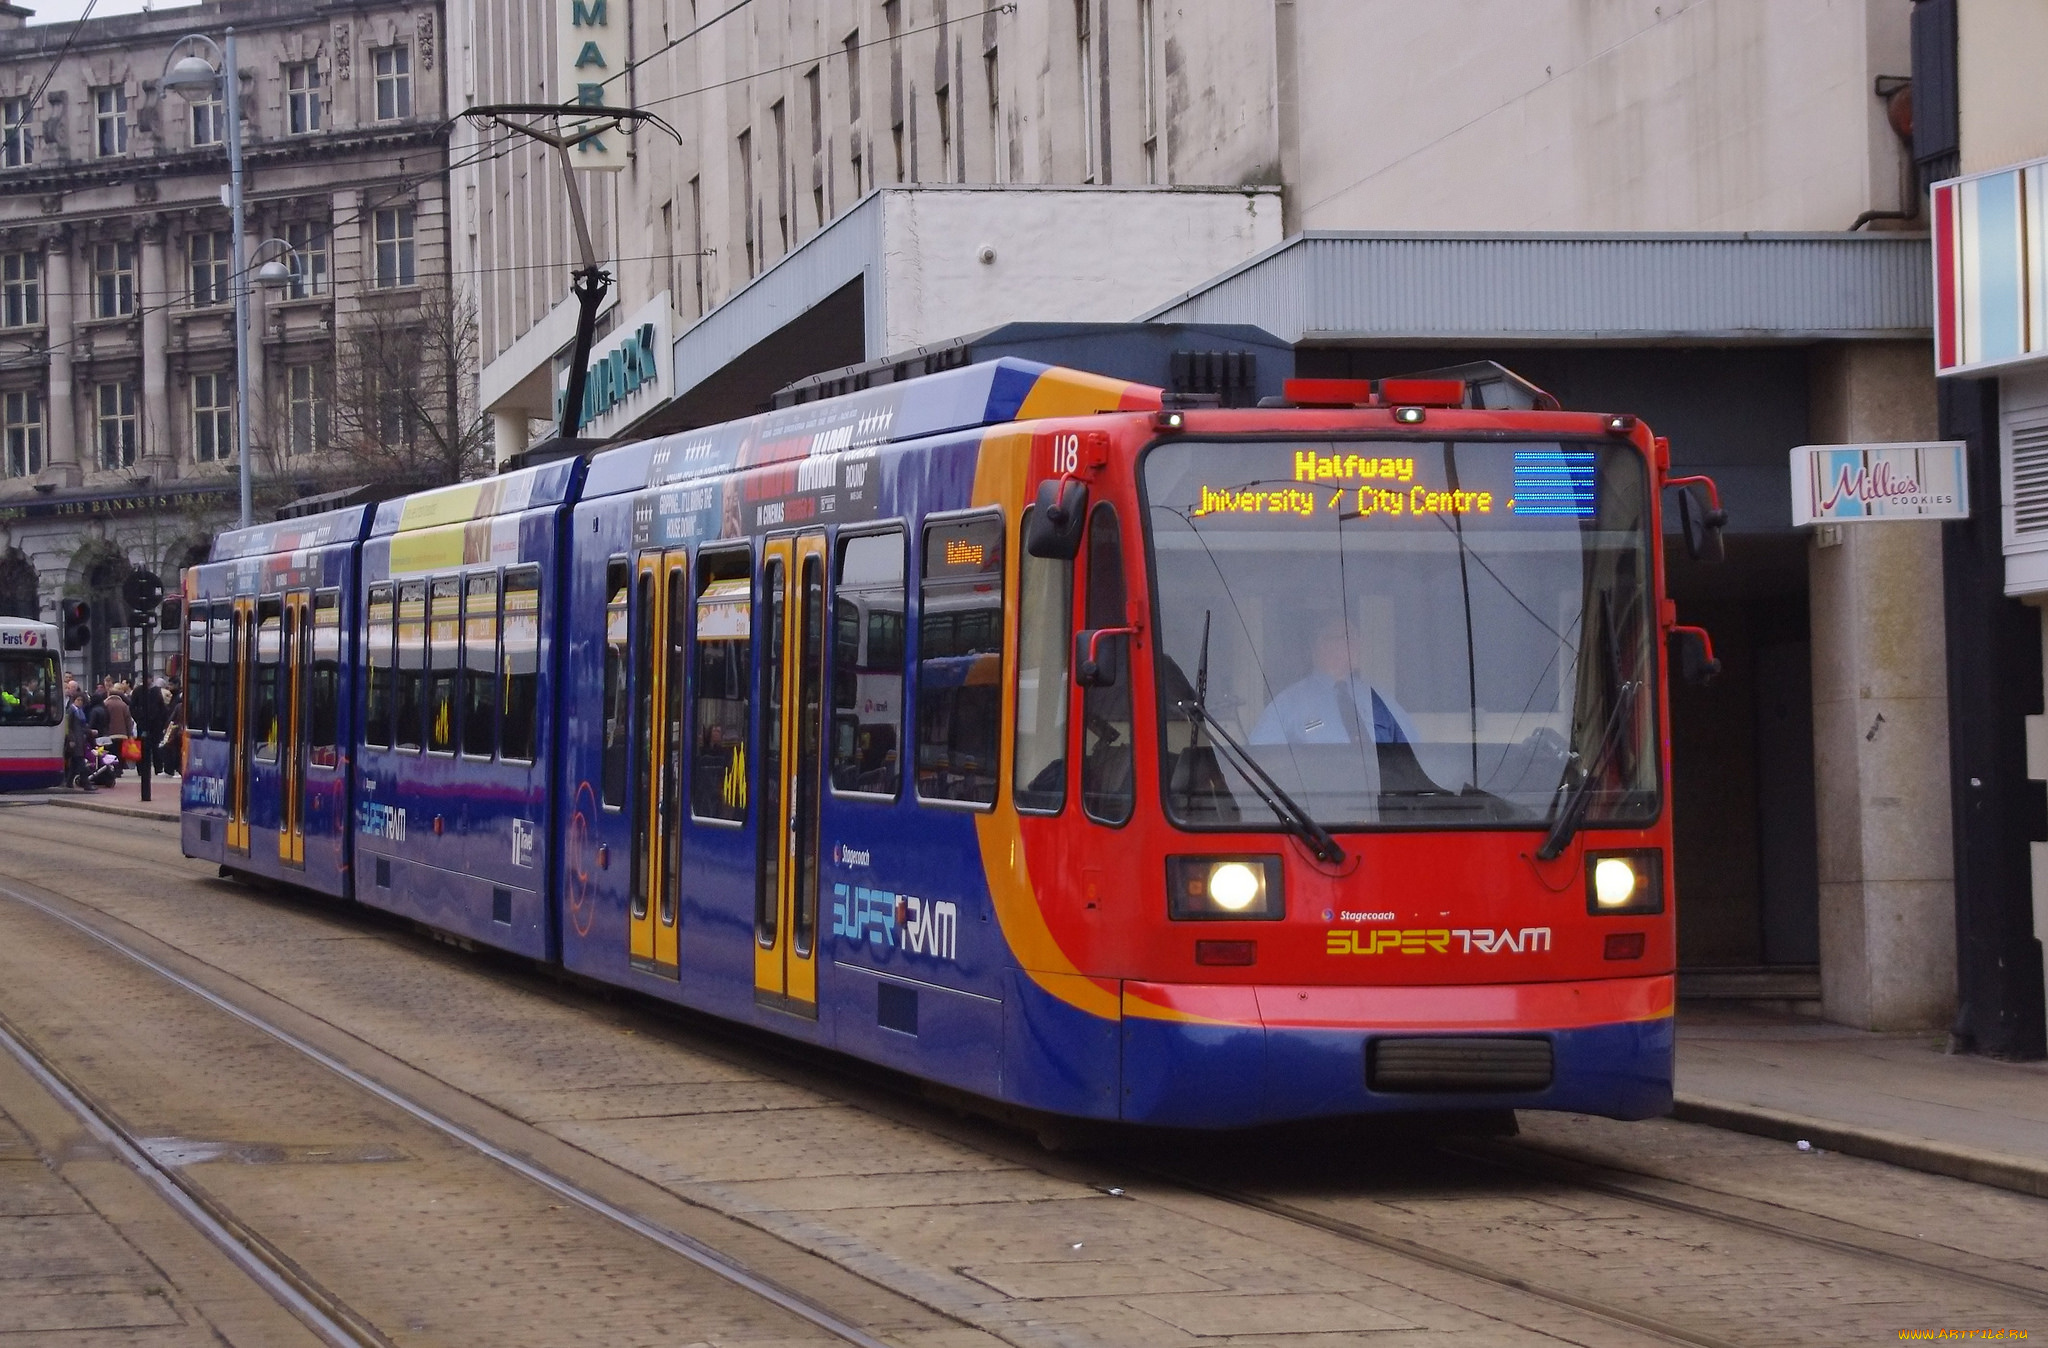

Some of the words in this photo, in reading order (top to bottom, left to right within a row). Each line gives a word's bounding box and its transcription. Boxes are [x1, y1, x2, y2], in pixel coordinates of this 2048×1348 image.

[556, 322, 657, 432] PMARK
[1053, 434, 1079, 473] 118
[1295, 451, 1413, 481] Halfway
[1822, 461, 1918, 510] Millie's
[56, 502, 84, 515] THE
[1358, 485, 1404, 515] City
[1411, 485, 1492, 515] Centre
[1891, 495, 1952, 505] COOKIES
[2, 632, 22, 646] First
[842, 844, 870, 869] Stagecoach
[1340, 910, 1395, 923] Stagecoach
[1327, 927, 1551, 954] SUPERTRAM
